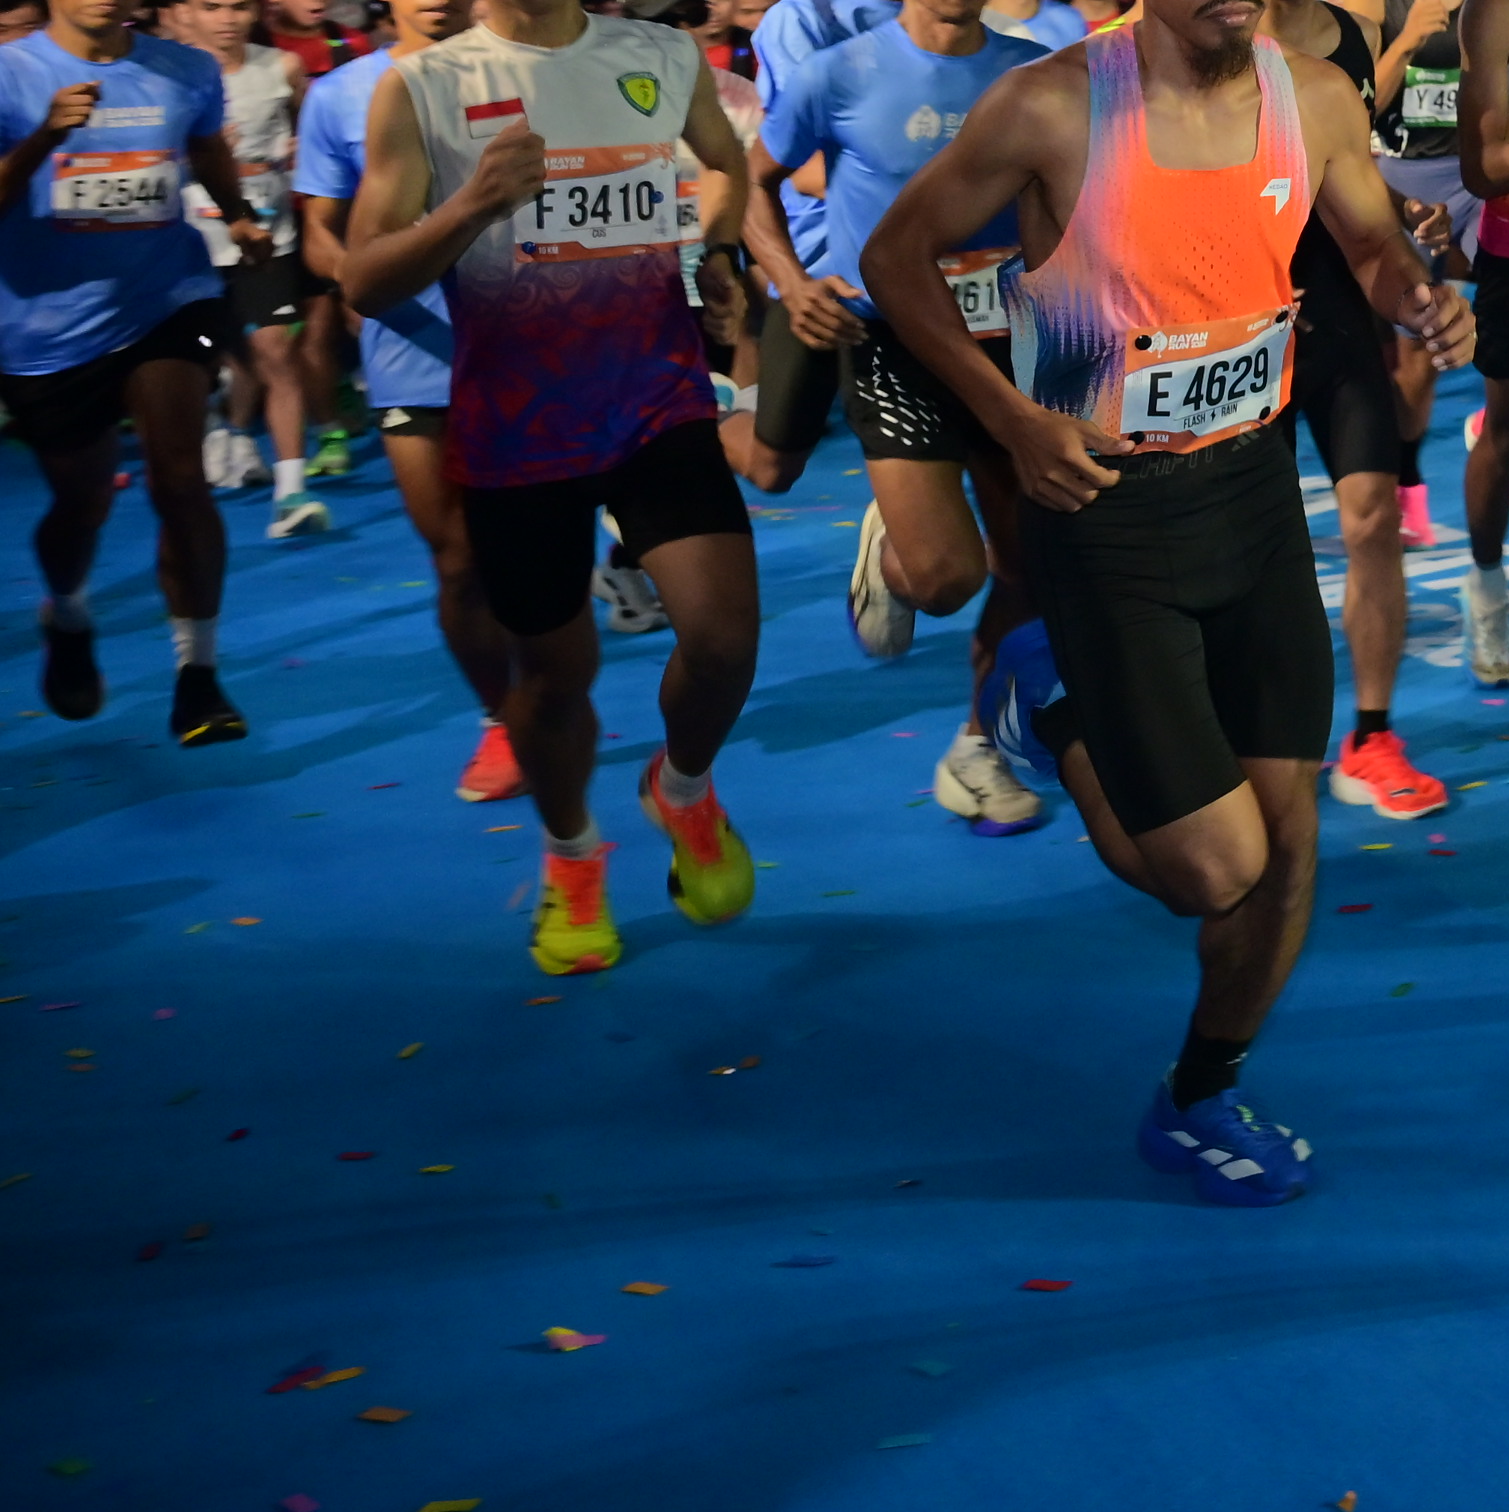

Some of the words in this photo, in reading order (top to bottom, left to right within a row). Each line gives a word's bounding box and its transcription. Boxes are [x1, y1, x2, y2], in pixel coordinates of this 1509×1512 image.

[1416, 89, 1428, 109] Y
[74, 179, 87, 209] F
[97, 176, 168, 208] 2544
[535, 188, 555, 229] F
[568, 181, 655, 227] 3410
[1168, 331, 1208, 344] BAYAN
[1147, 371, 1173, 417] E
[1182, 347, 1269, 412] 4629
[1183, 413, 1206, 429] FLASH
[1221, 403, 1238, 418] RAIN
[1146, 434, 1155, 442] 10
[1156, 434, 1169, 442] KM
